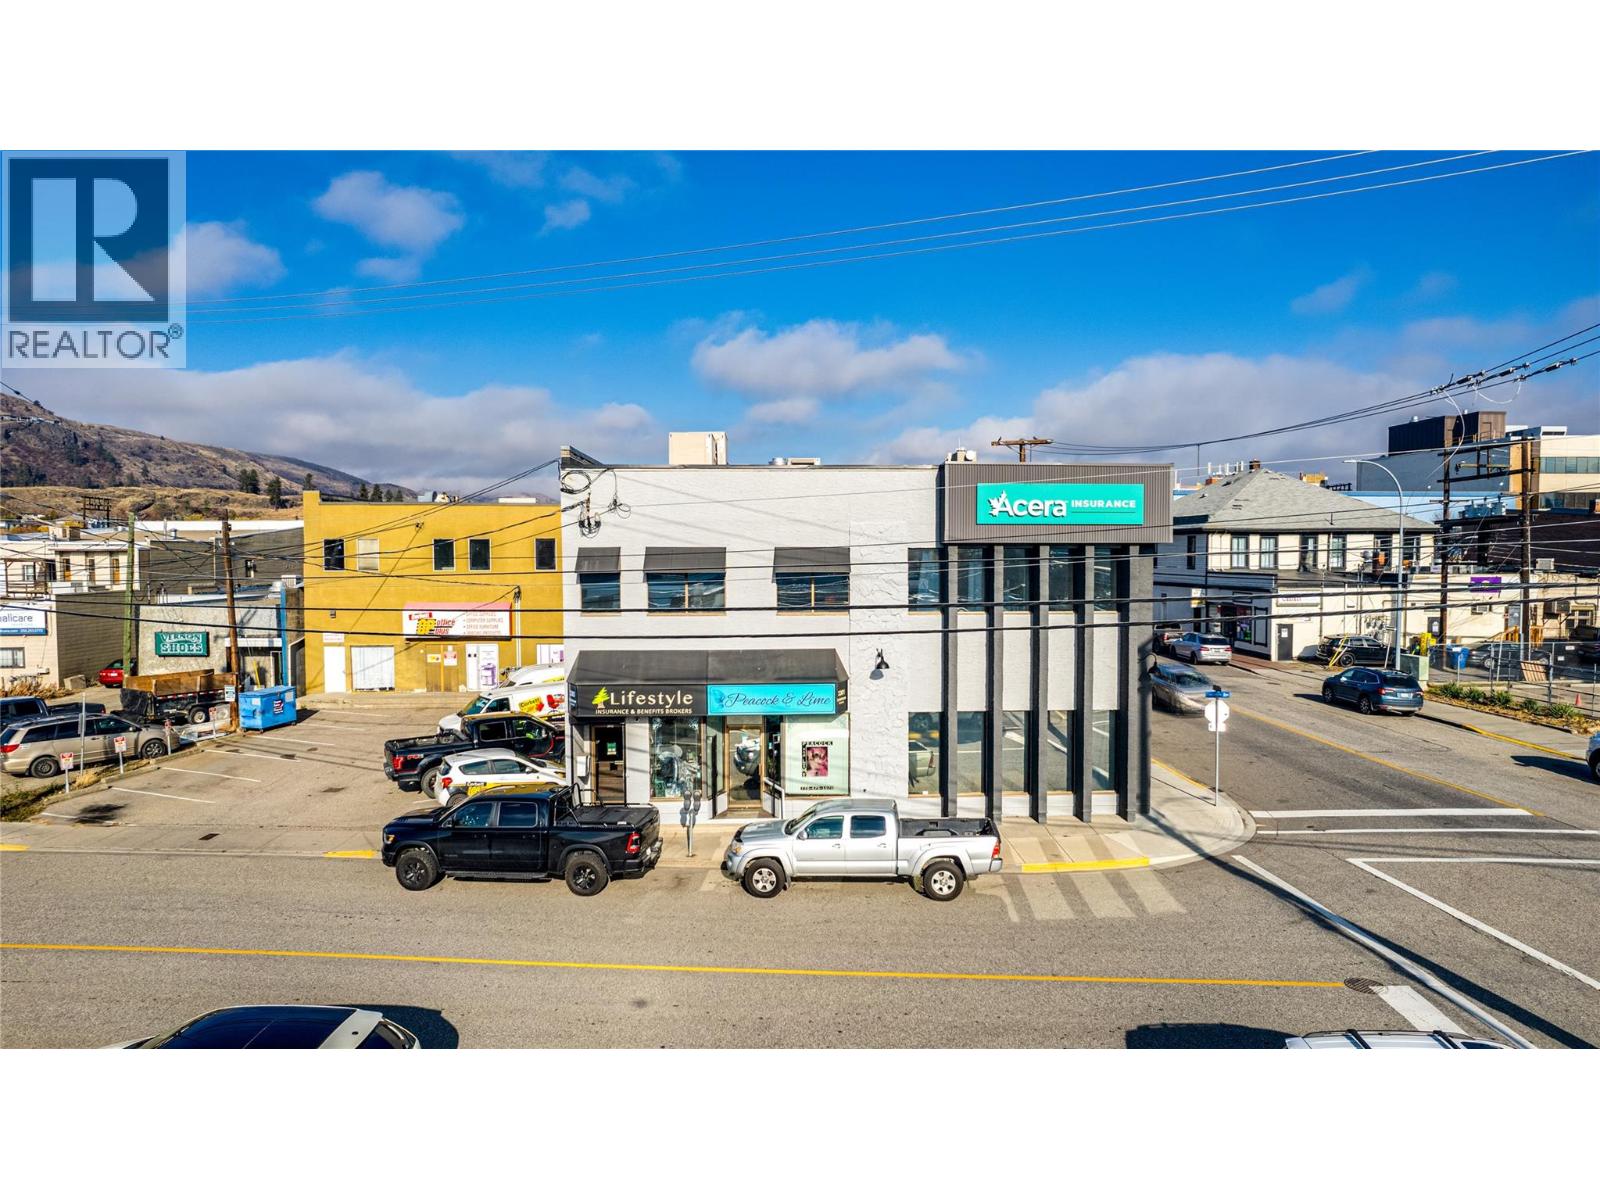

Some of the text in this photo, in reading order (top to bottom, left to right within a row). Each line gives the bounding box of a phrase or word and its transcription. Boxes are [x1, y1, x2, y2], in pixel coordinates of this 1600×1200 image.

[992, 491, 1137, 517] Acera INSURANCE
[0, 613, 33, 623] alicare
[160, 642, 203, 654] SHOES
[610, 690, 694, 708] Lifestyle
[725, 693, 779, 708] Peacock
[781, 690, 797, 705] &
[797, 691, 832, 707] Lime
